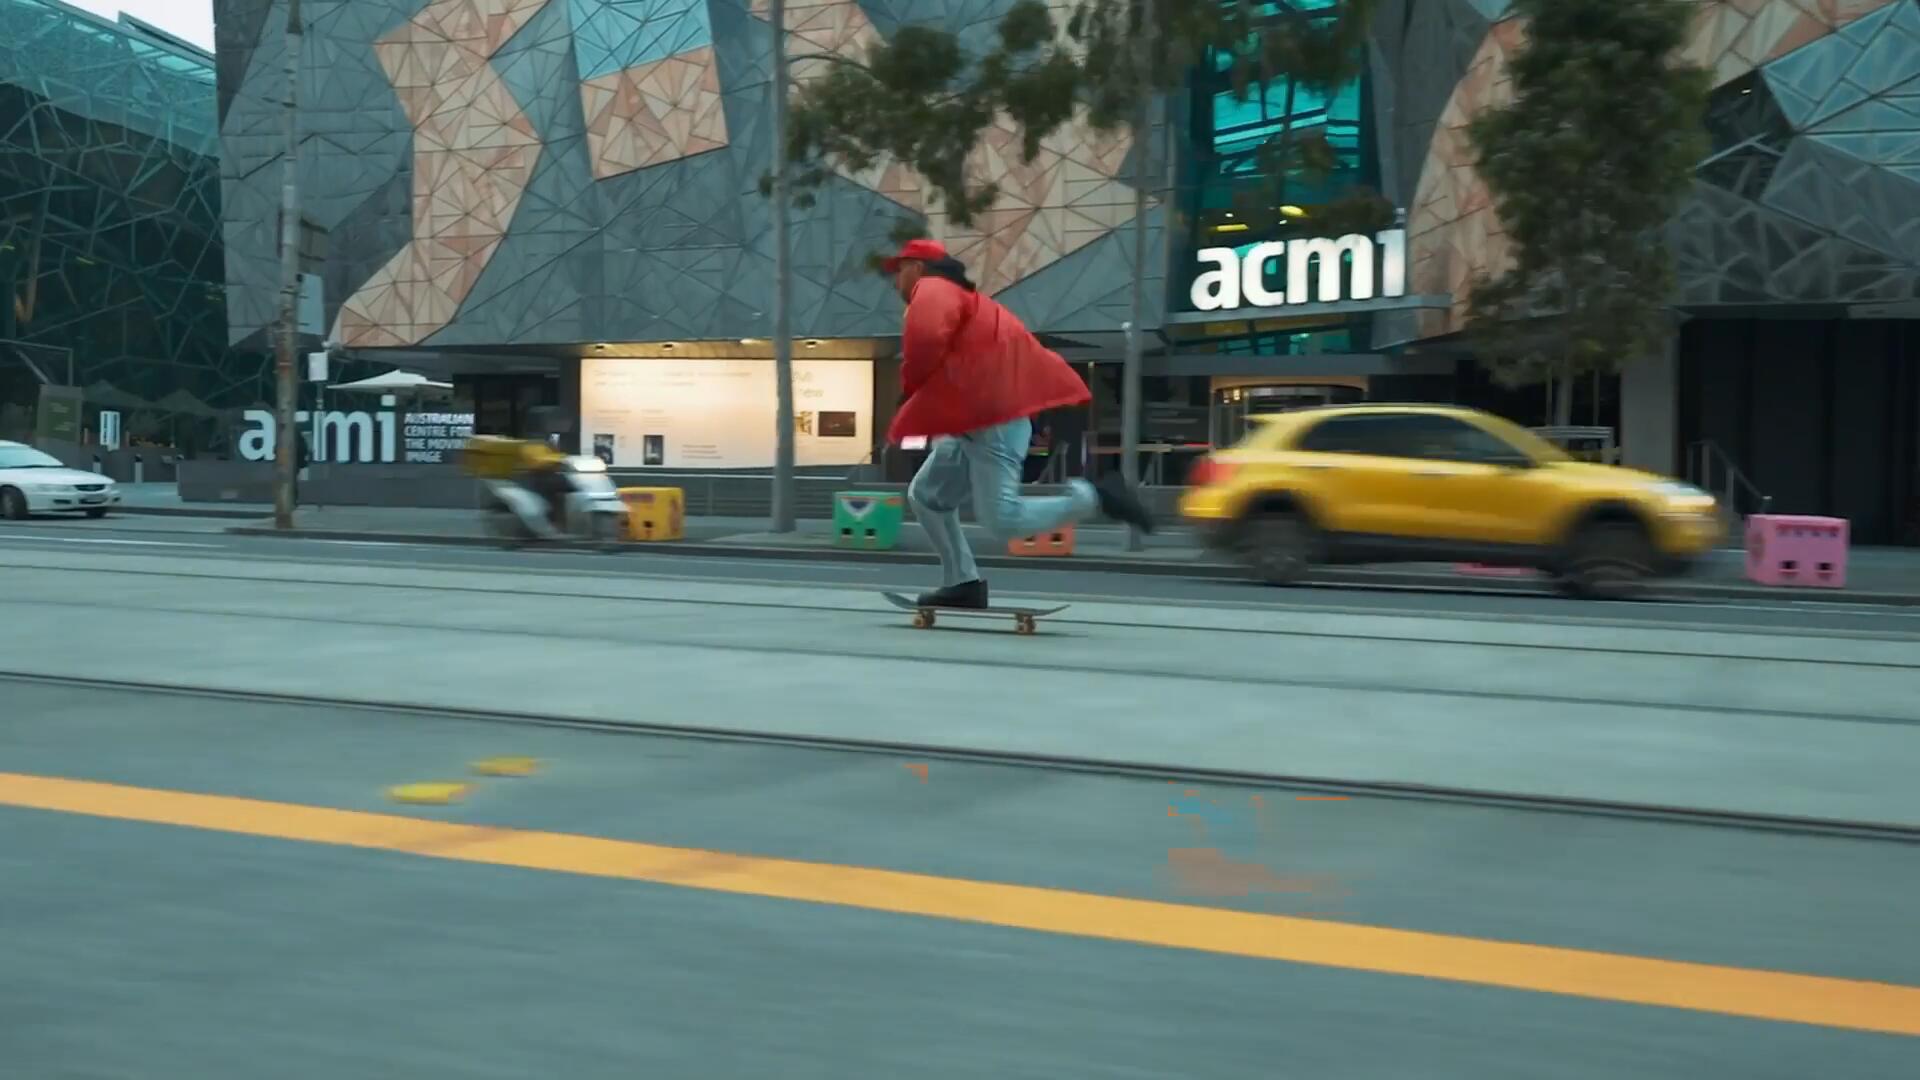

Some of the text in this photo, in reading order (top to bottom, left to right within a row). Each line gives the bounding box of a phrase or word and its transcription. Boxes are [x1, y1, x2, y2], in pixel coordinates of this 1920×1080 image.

[1191, 209, 1406, 310] acmi
[404, 413, 475, 424] AUSTRALIAN
[404, 425, 474, 436] CENTRE FOR
[405, 438, 426, 449] THE
[405, 451, 442, 463] IMAGE
